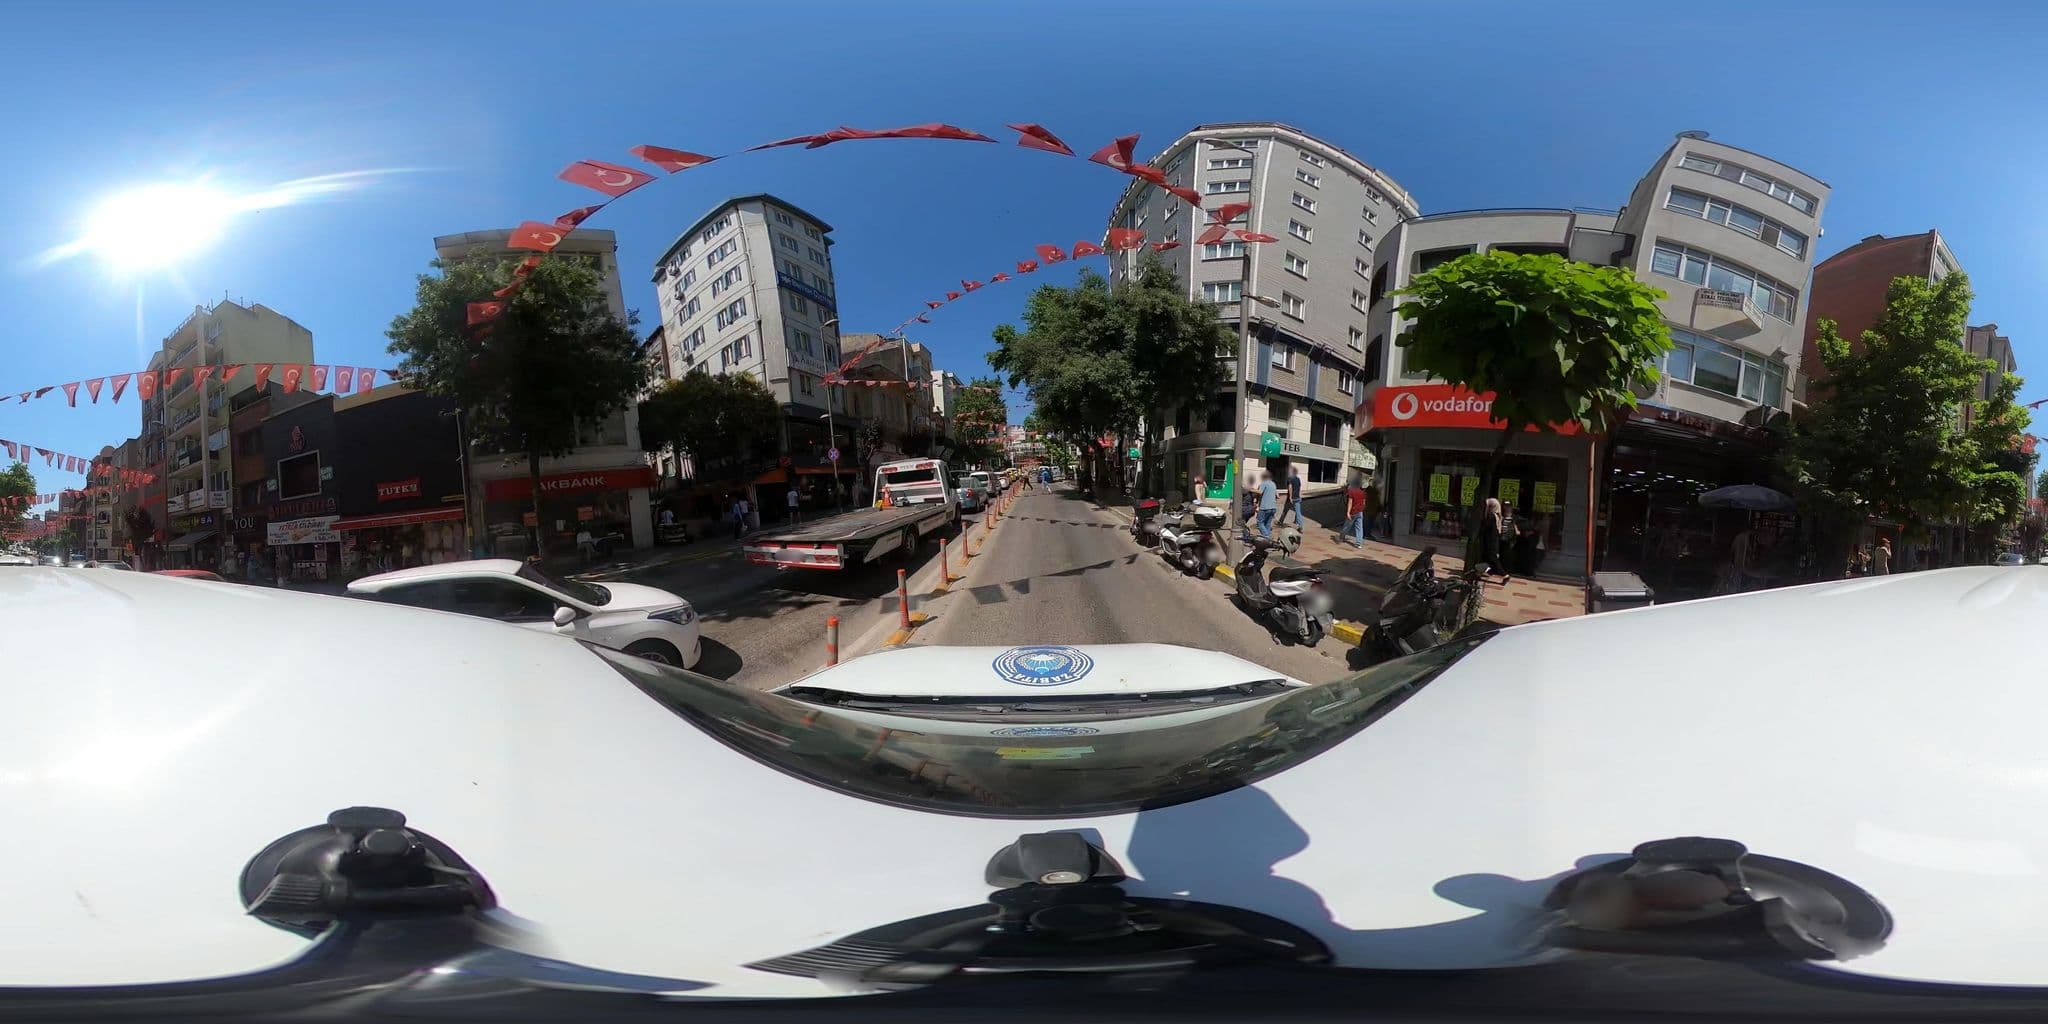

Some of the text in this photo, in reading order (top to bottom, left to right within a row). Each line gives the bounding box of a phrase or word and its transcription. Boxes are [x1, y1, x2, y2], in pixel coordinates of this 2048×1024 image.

[1423, 396, 1493, 412] vodafon
[1283, 441, 1301, 453] TEB
[1013, 672, 1074, 685] ZABITA
